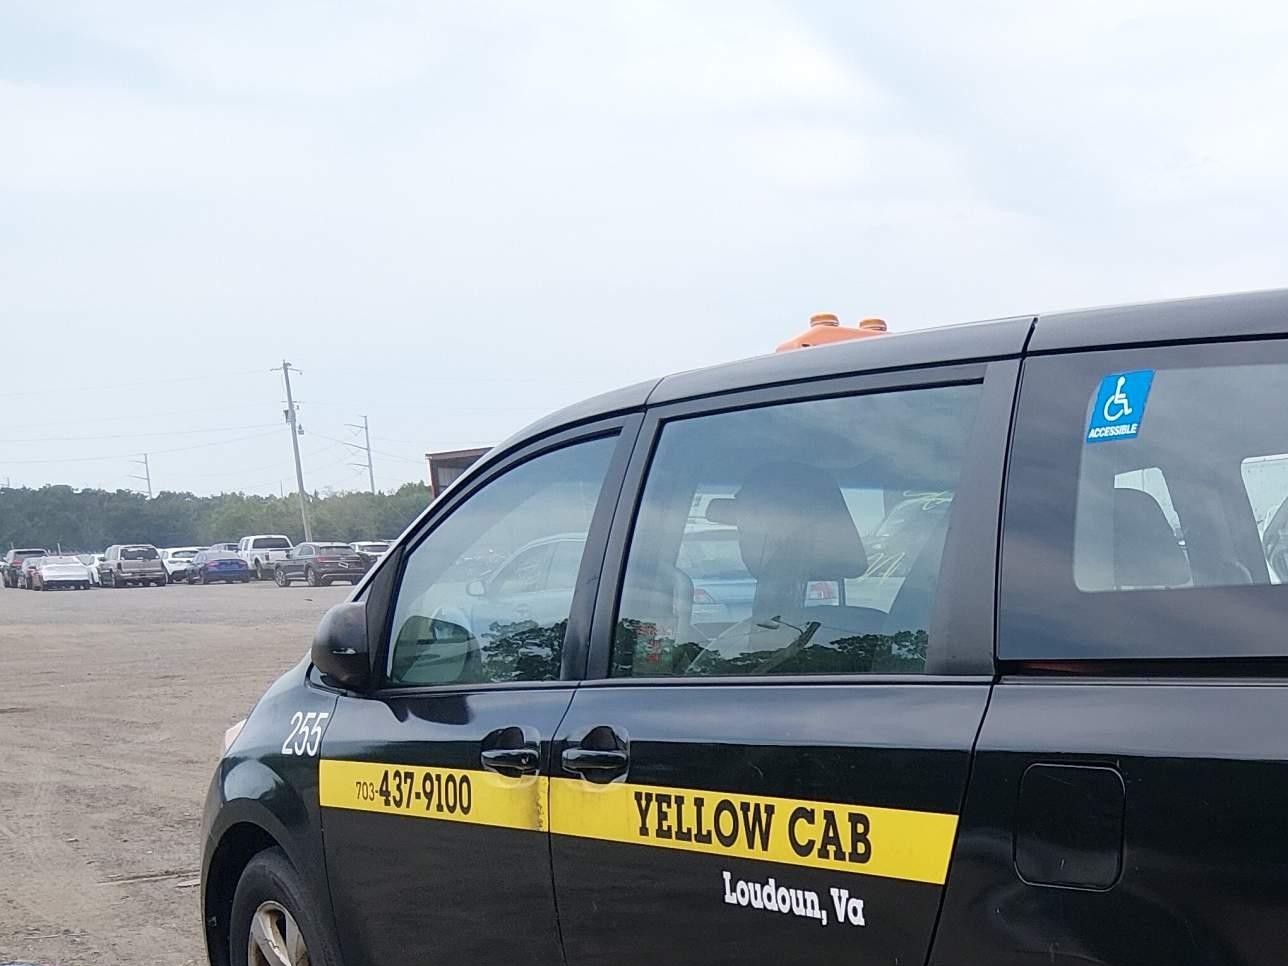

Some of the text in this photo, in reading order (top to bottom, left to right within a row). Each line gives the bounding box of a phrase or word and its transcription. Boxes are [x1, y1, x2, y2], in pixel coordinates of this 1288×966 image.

[1087, 423, 1138, 439] ACCESSIBLE
[281, 710, 328, 758] 255
[355, 769, 472, 816] 703-437-9100
[634, 791, 872, 864] YELLOW CAB
[722, 870, 866, 926] Loudoun, Va
